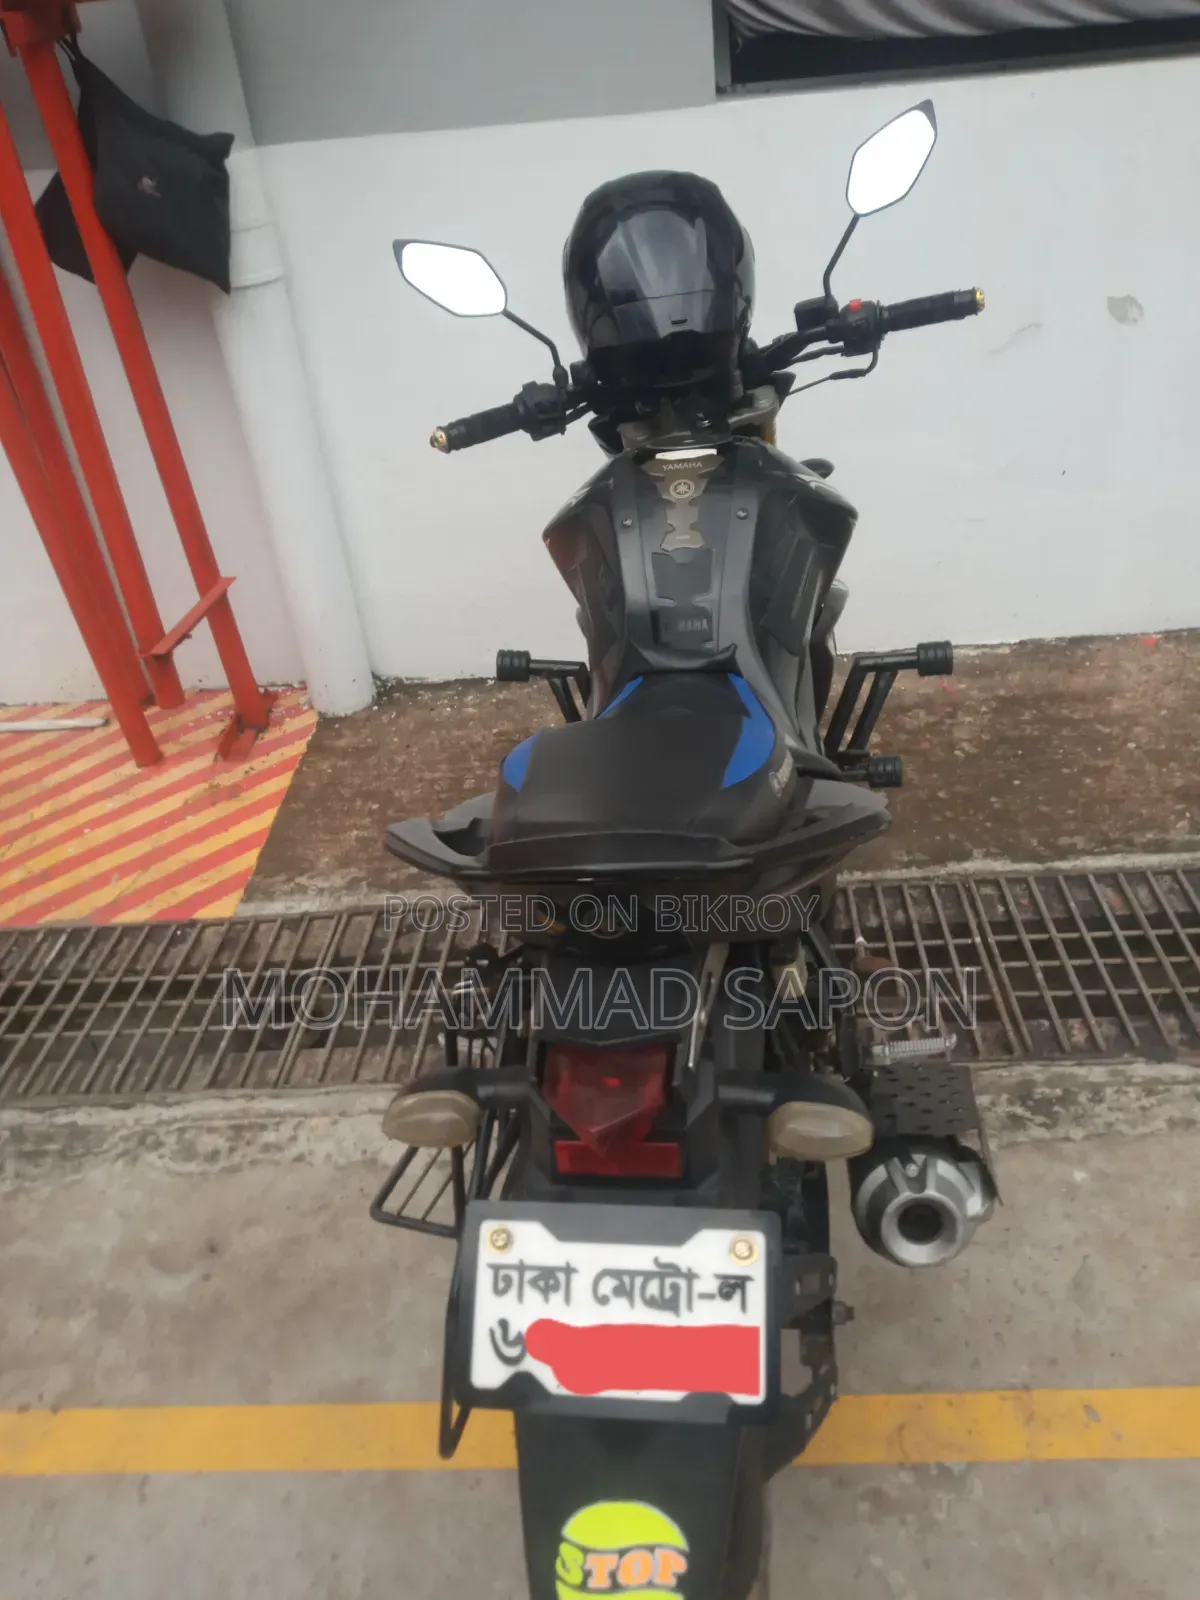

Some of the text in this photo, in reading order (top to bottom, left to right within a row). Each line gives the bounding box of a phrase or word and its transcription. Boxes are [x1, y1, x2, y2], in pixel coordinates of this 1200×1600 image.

[662, 461, 703, 471] YAMAHA
[486, 1258, 579, 1307] ঢাকা
[555, 1541, 688, 1591] STOP
